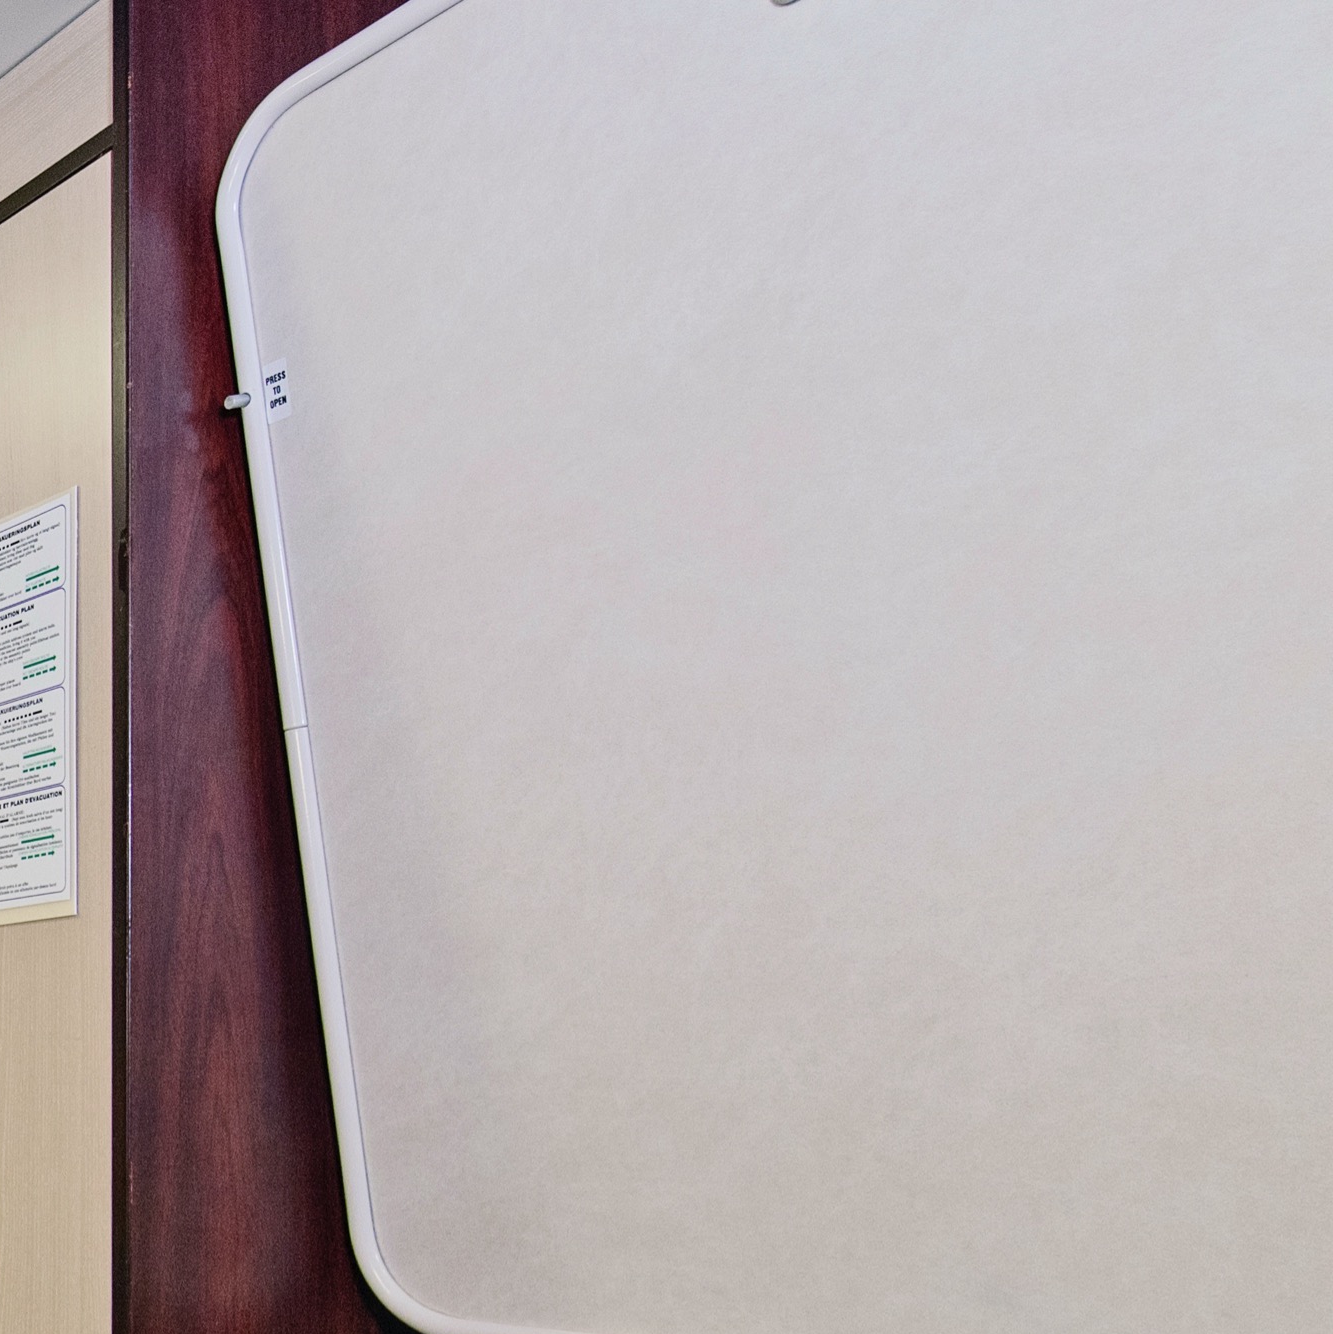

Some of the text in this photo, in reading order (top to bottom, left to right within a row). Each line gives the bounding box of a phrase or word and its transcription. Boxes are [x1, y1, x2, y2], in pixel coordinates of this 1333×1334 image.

[265, 370, 286, 386] PRESS
[273, 385, 281, 395] TO
[269, 395, 287, 409] OPEN
[20, 604, 35, 615] PLAN
[10, 799, 24, 808] PLAN
